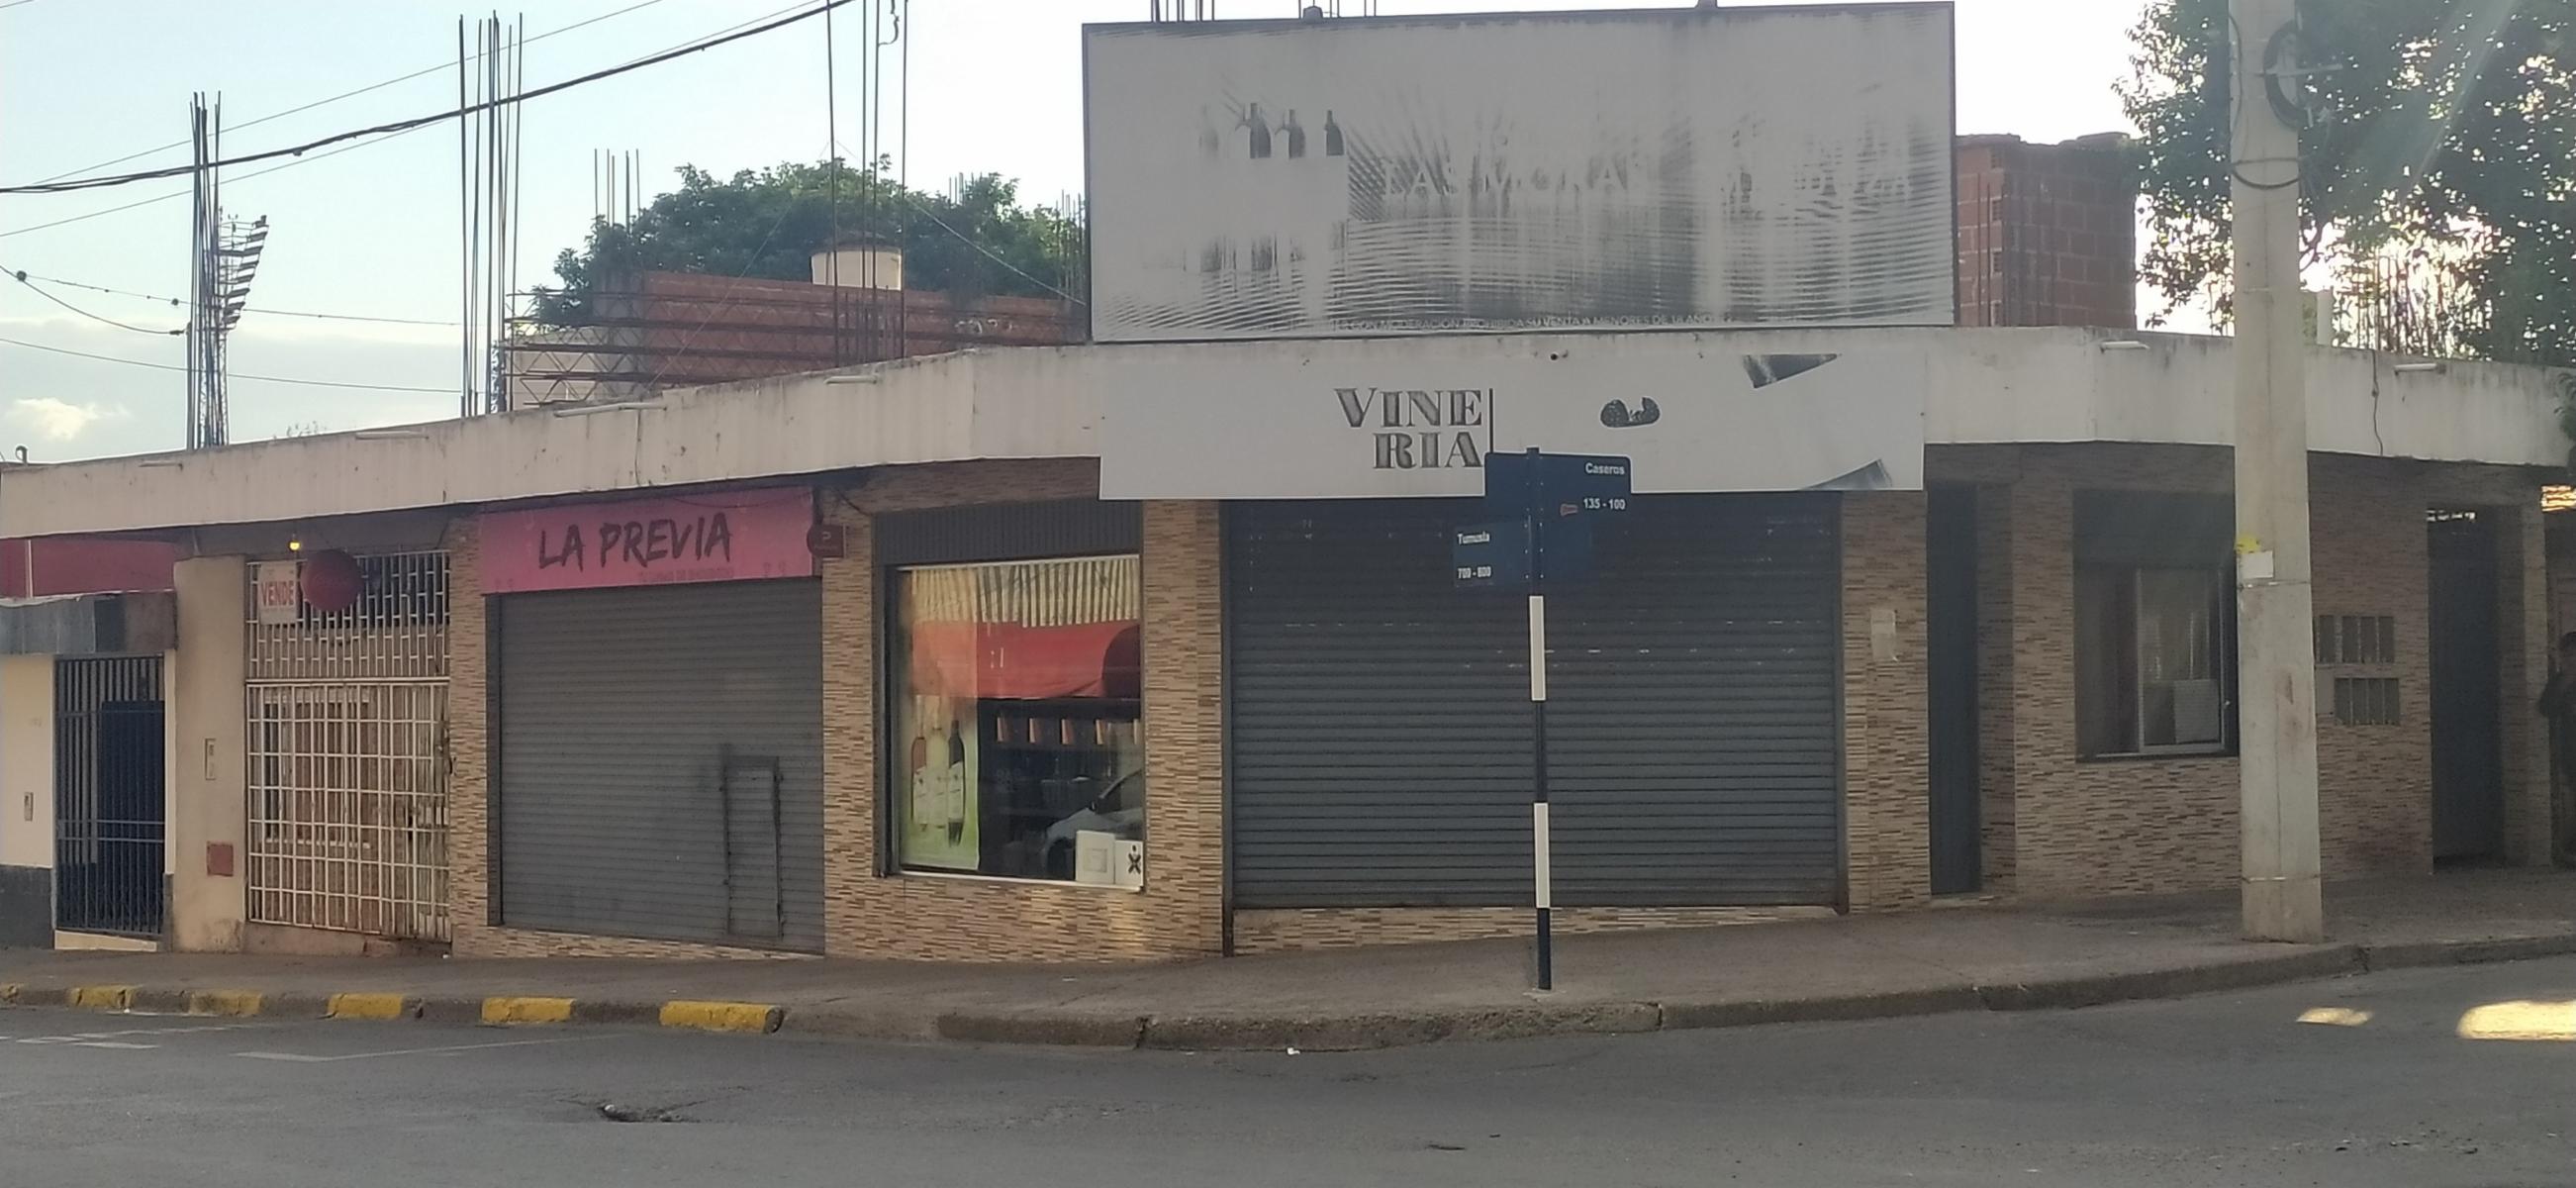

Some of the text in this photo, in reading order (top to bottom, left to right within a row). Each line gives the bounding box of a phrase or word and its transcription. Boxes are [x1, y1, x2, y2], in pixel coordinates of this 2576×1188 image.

[1543, 315, 1580, 327] VENTA
[1333, 387, 1482, 428] VINE
[1372, 431, 1483, 469] RIA
[1585, 462, 1626, 475] Caseros
[538, 512, 732, 572] LA PREVIA
[261, 581, 295, 607] VENDE
